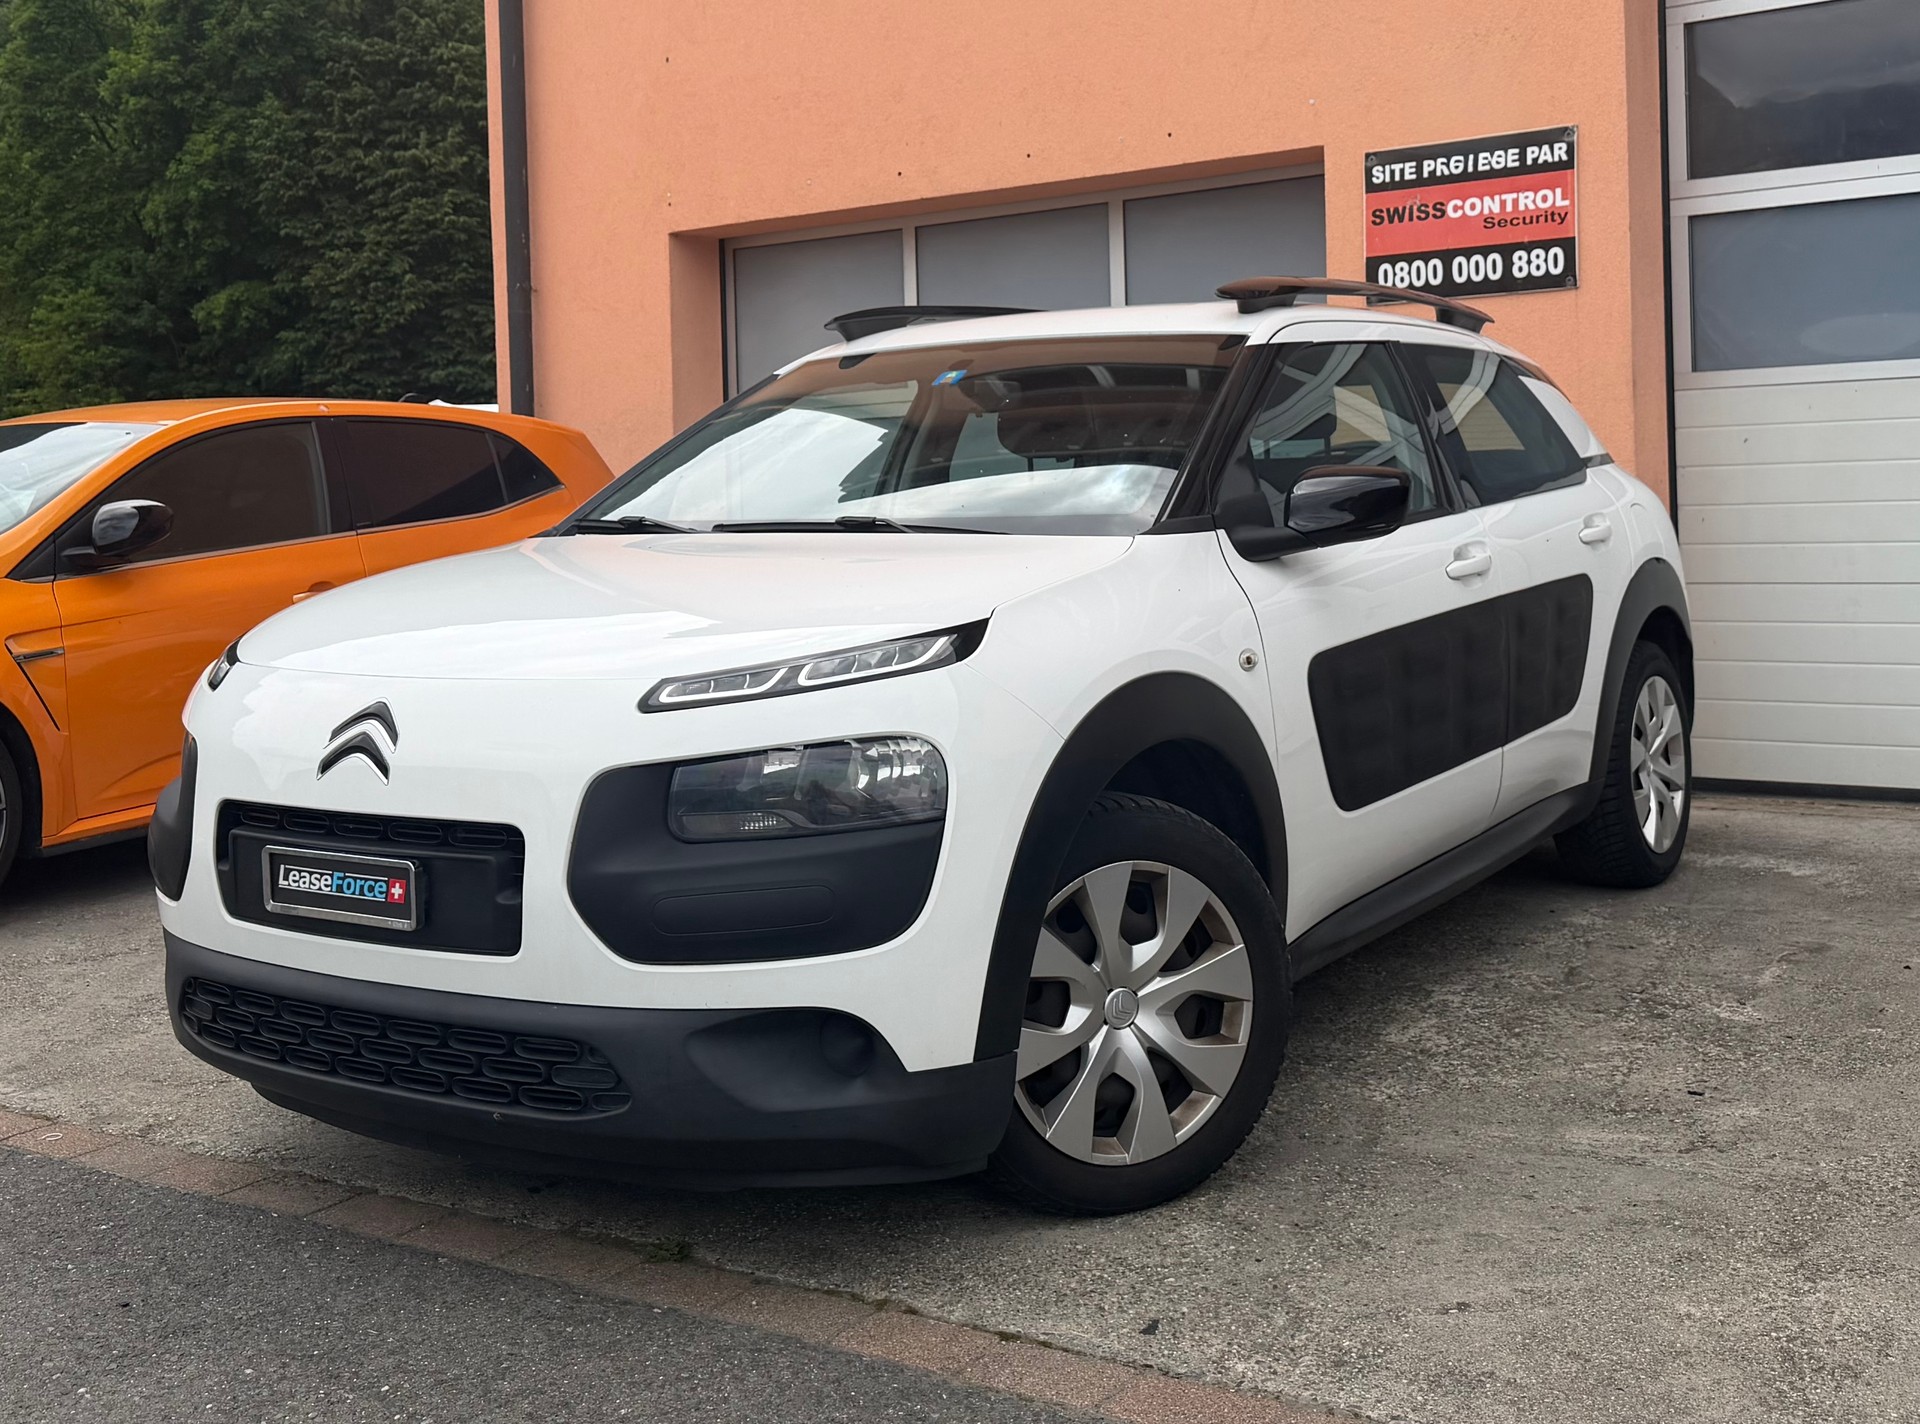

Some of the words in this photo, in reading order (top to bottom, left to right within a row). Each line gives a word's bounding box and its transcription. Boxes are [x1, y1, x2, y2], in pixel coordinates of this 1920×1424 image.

[1371, 161, 1417, 184] SITE
[1526, 142, 1568, 165] PAR
[1483, 210, 1568, 229] Security
[1378, 258, 1443, 289] 0800
[1452, 252, 1503, 284] 000
[1512, 246, 1565, 278] 880
[278, 864, 387, 898] LeaseForce
